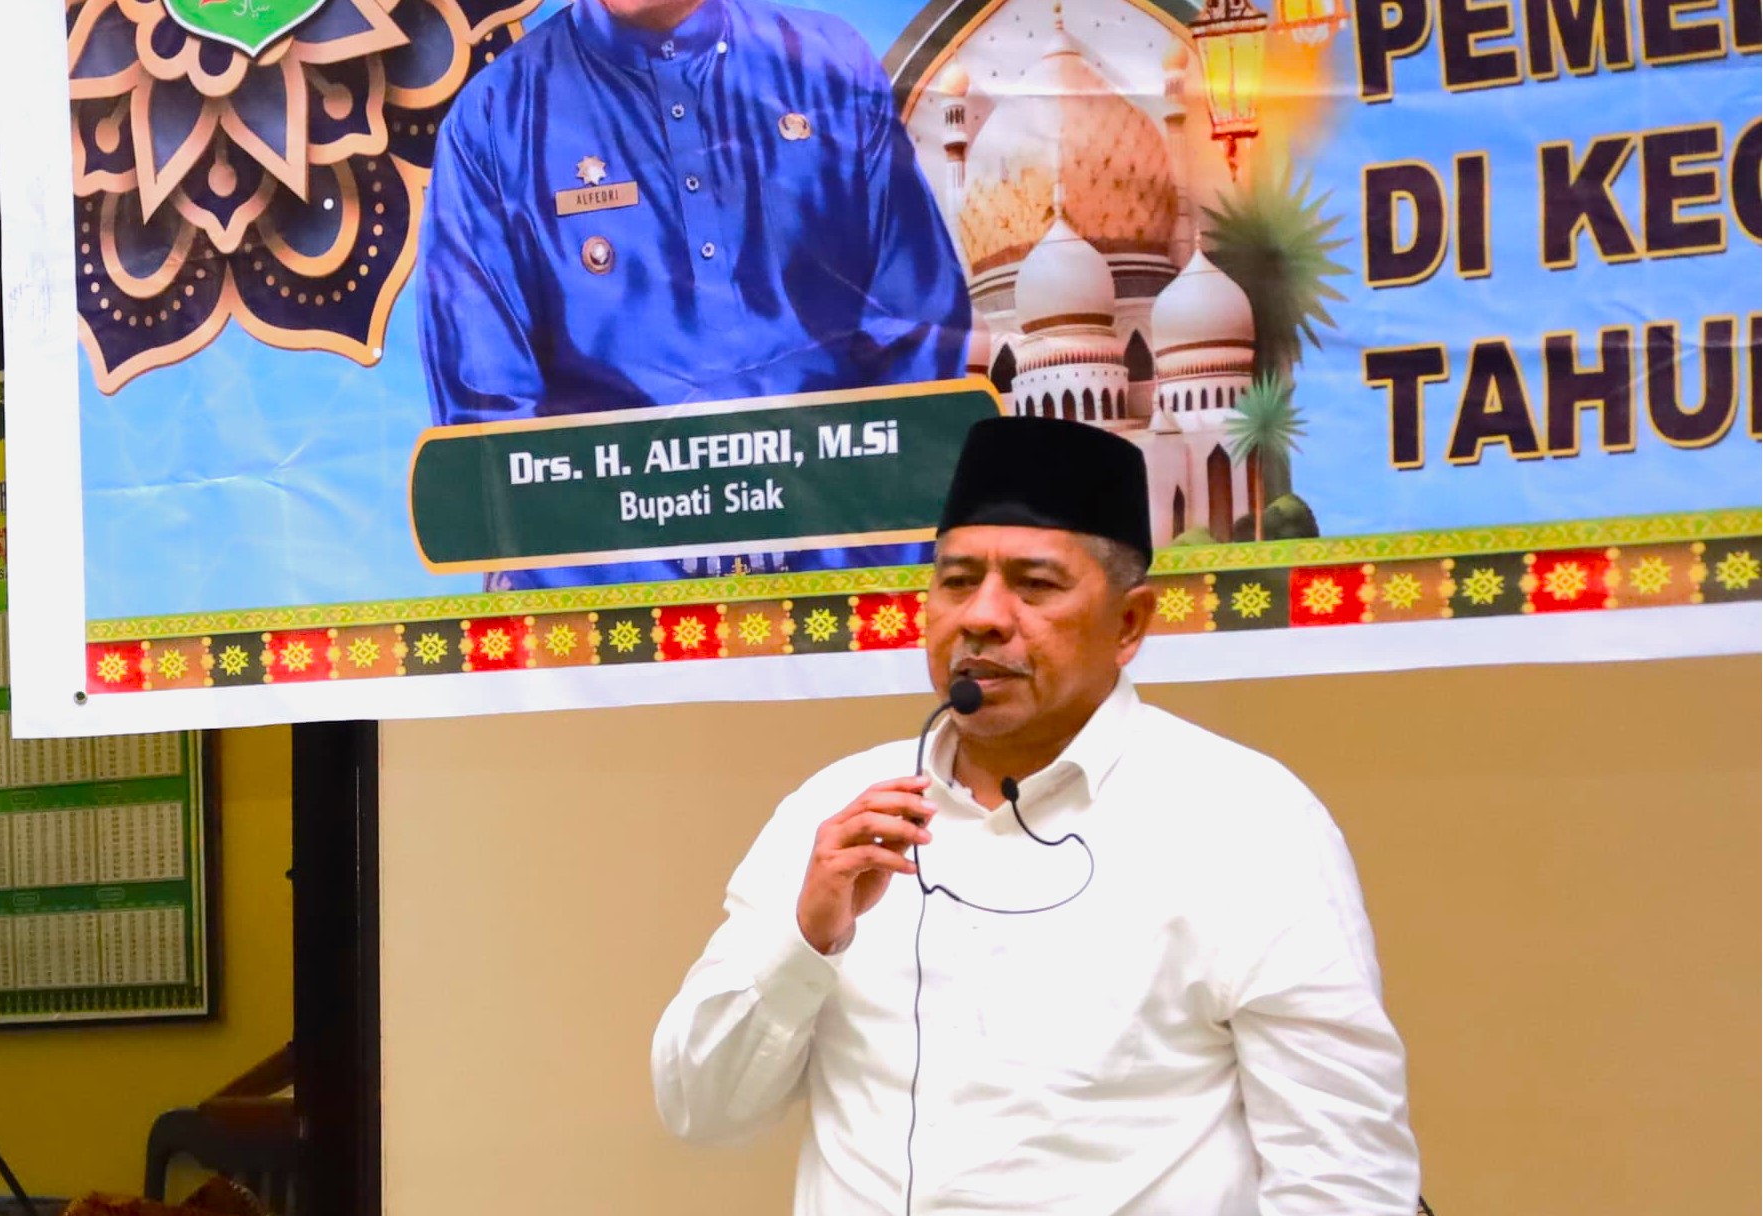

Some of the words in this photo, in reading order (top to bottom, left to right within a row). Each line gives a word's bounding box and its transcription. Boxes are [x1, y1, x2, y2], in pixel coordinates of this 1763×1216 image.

[1353, 0, 1763, 103] PEME
[577, 190, 619, 206] ALFEDRI
[1362, 150, 1491, 290] DI
[1363, 311, 1763, 471] TAHU
[509, 450, 583, 486] Drs.
[595, 444, 631, 479] H.
[643, 428, 804, 475] ALFEDRI,
[817, 420, 898, 460] M.Si
[620, 484, 712, 526] Bupati
[726, 478, 784, 512] Siak
